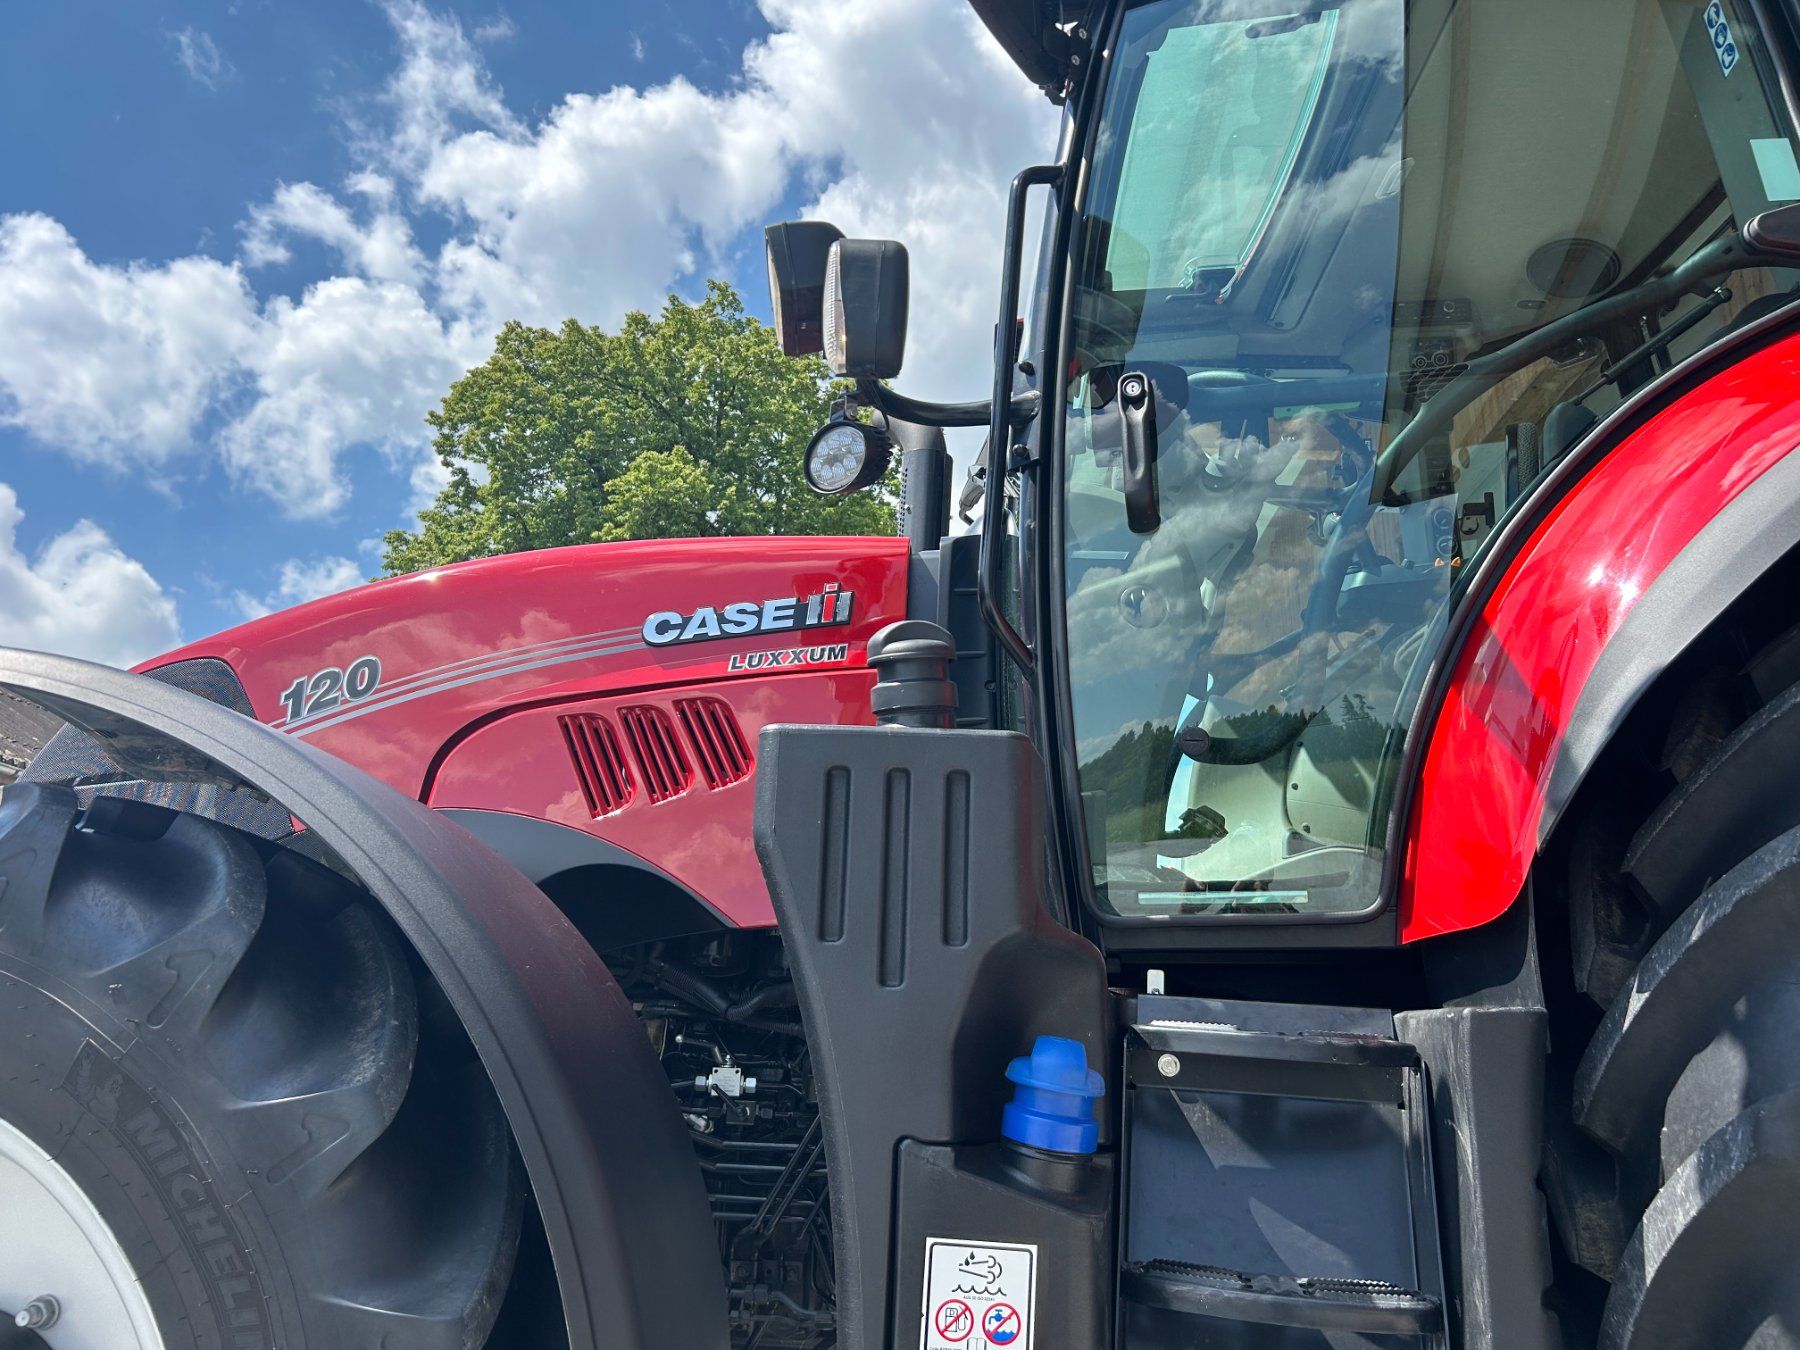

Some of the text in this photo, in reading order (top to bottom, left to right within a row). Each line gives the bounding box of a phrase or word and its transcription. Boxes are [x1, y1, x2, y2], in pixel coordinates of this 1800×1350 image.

[642, 597, 799, 645] CASE
[728, 644, 849, 672] LUXXUM
[280, 655, 382, 725] 120
